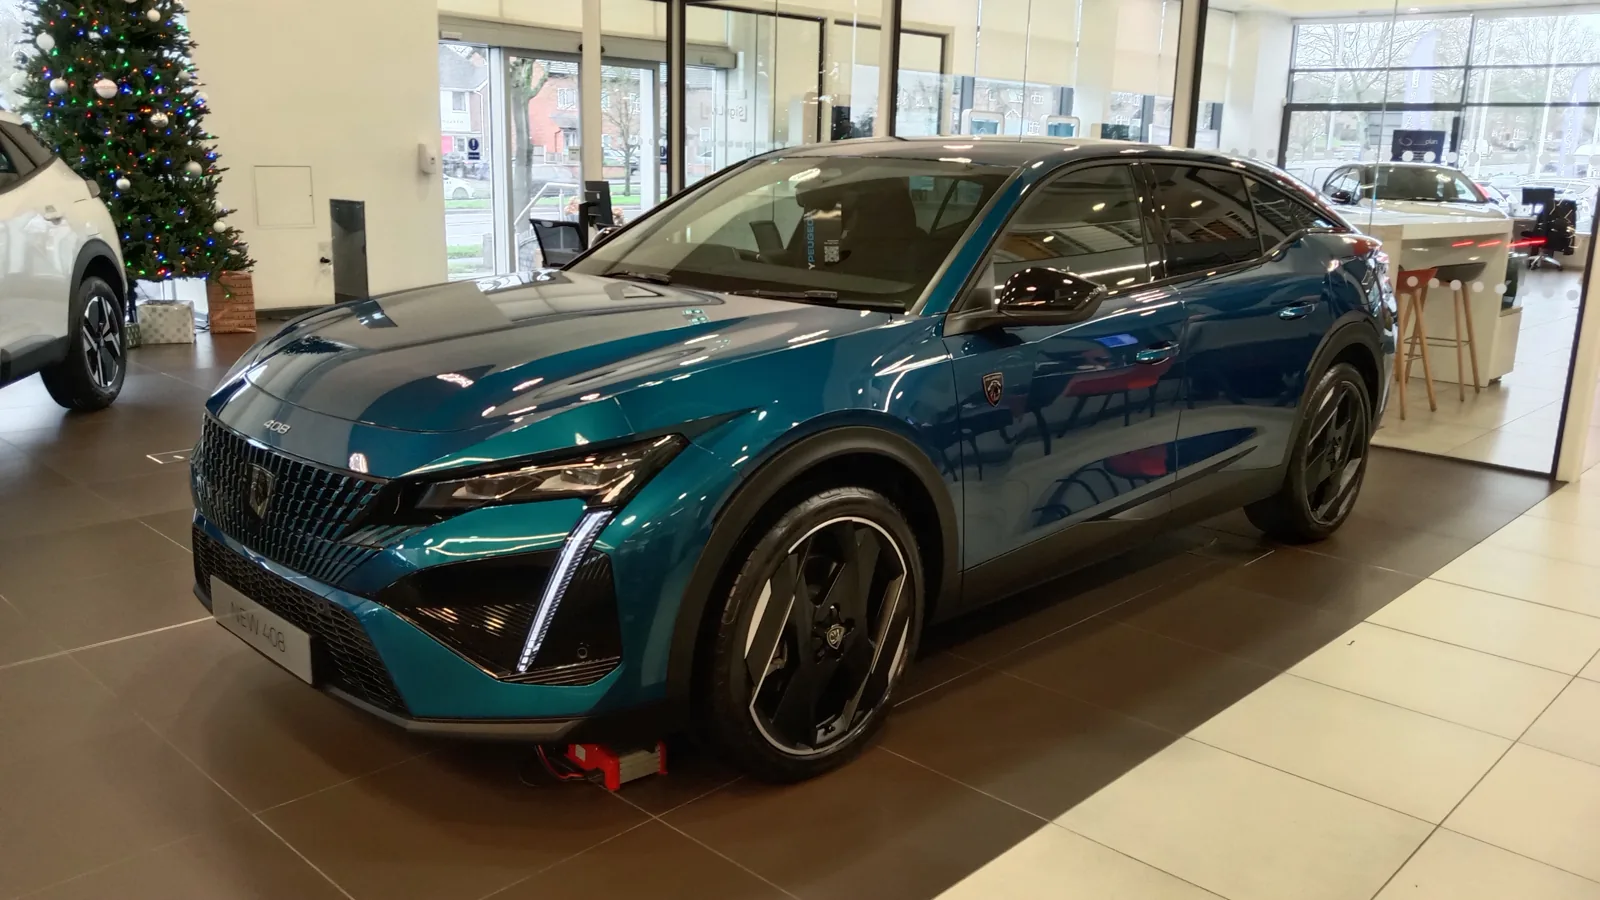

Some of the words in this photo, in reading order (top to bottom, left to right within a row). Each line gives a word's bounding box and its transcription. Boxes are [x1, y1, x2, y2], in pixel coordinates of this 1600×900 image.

[807, 219, 816, 270] YPEUGEO
[263, 419, 291, 434] 408
[230, 601, 259, 635] NEW
[262, 623, 286, 653] 408
